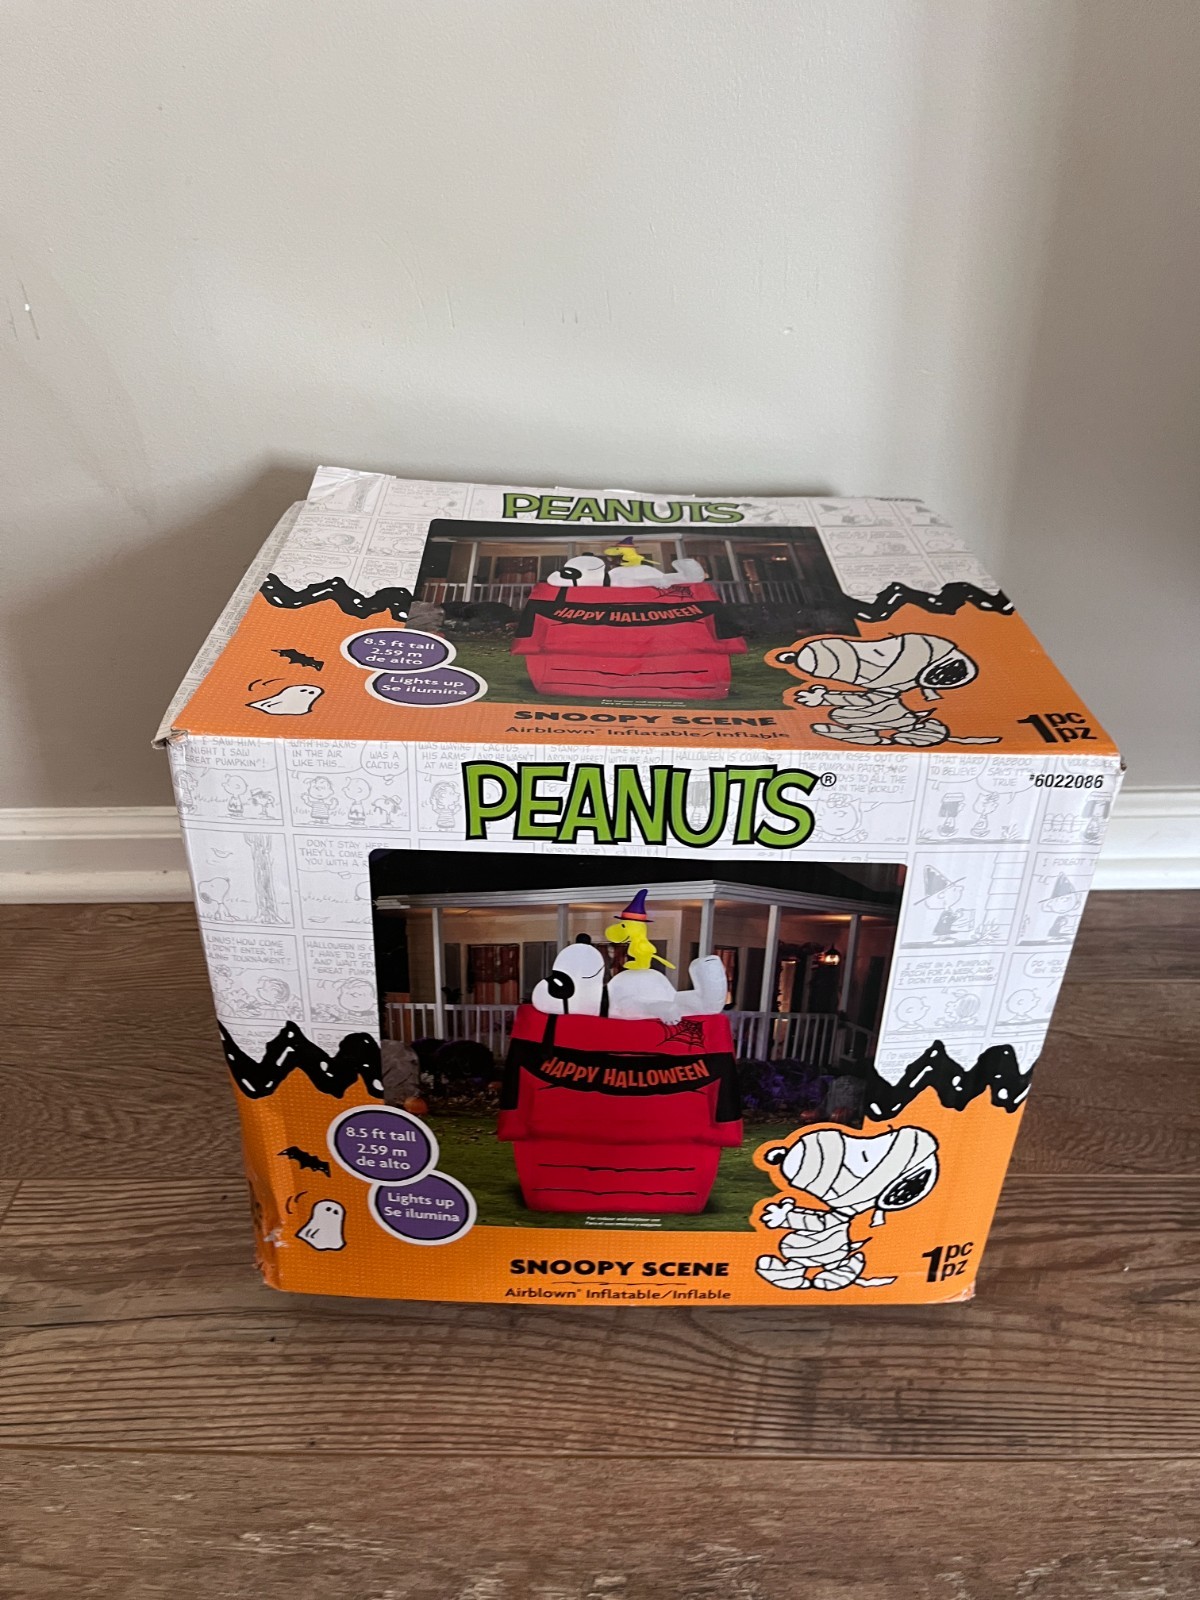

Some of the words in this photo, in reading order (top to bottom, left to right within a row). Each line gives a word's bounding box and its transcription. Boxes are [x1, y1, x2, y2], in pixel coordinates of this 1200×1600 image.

[502, 493, 745, 524] PEANUTS
[553, 607, 605, 622] HAPPY
[609, 604, 703, 623] HALLOWEEN
[363, 637, 386, 646] 8.5
[391, 639, 405, 648] ft
[409, 641, 436, 650] tall
[370, 647, 403, 656] 2.59
[365, 654, 386, 663] de
[390, 657, 423, 666] alto
[381, 684, 402, 692] Se
[406, 685, 468, 696] ilumina
[390, 676, 440, 686] Lights
[443, 680, 465, 689] up
[513, 710, 662, 725] SNOOPY
[671, 716, 778, 727] SCENE
[1043, 712, 1087, 727] pc
[1016, 714, 1059, 743] 1
[1054, 727, 1099, 743] pz
[366, 761, 401, 770] CACTUS
[540, 1057, 600, 1083] HAPPY
[603, 1059, 710, 1088] HALLOWEEN
[345, 1127, 368, 1138] 8.5
[371, 1128, 386, 1140] ft
[389, 1131, 417, 1142] tall
[356, 1143, 388, 1156] 2.59
[392, 1148, 408, 1157] m
[356, 1156, 376, 1167] de
[379, 1158, 411, 1170] alto
[387, 1192, 432, 1206] Lights
[436, 1198, 455, 1209] up
[384, 1206, 401, 1217] Se
[405, 1208, 460, 1222] ilumina
[945, 1242, 975, 1263] pc
[509, 1259, 635, 1276] SNOOPY
[642, 1261, 729, 1277] SCENE
[921, 1246, 945, 1283] 1
[940, 1259, 969, 1282] pz
[586, 1289, 732, 1299] Inflatable/Inflable
